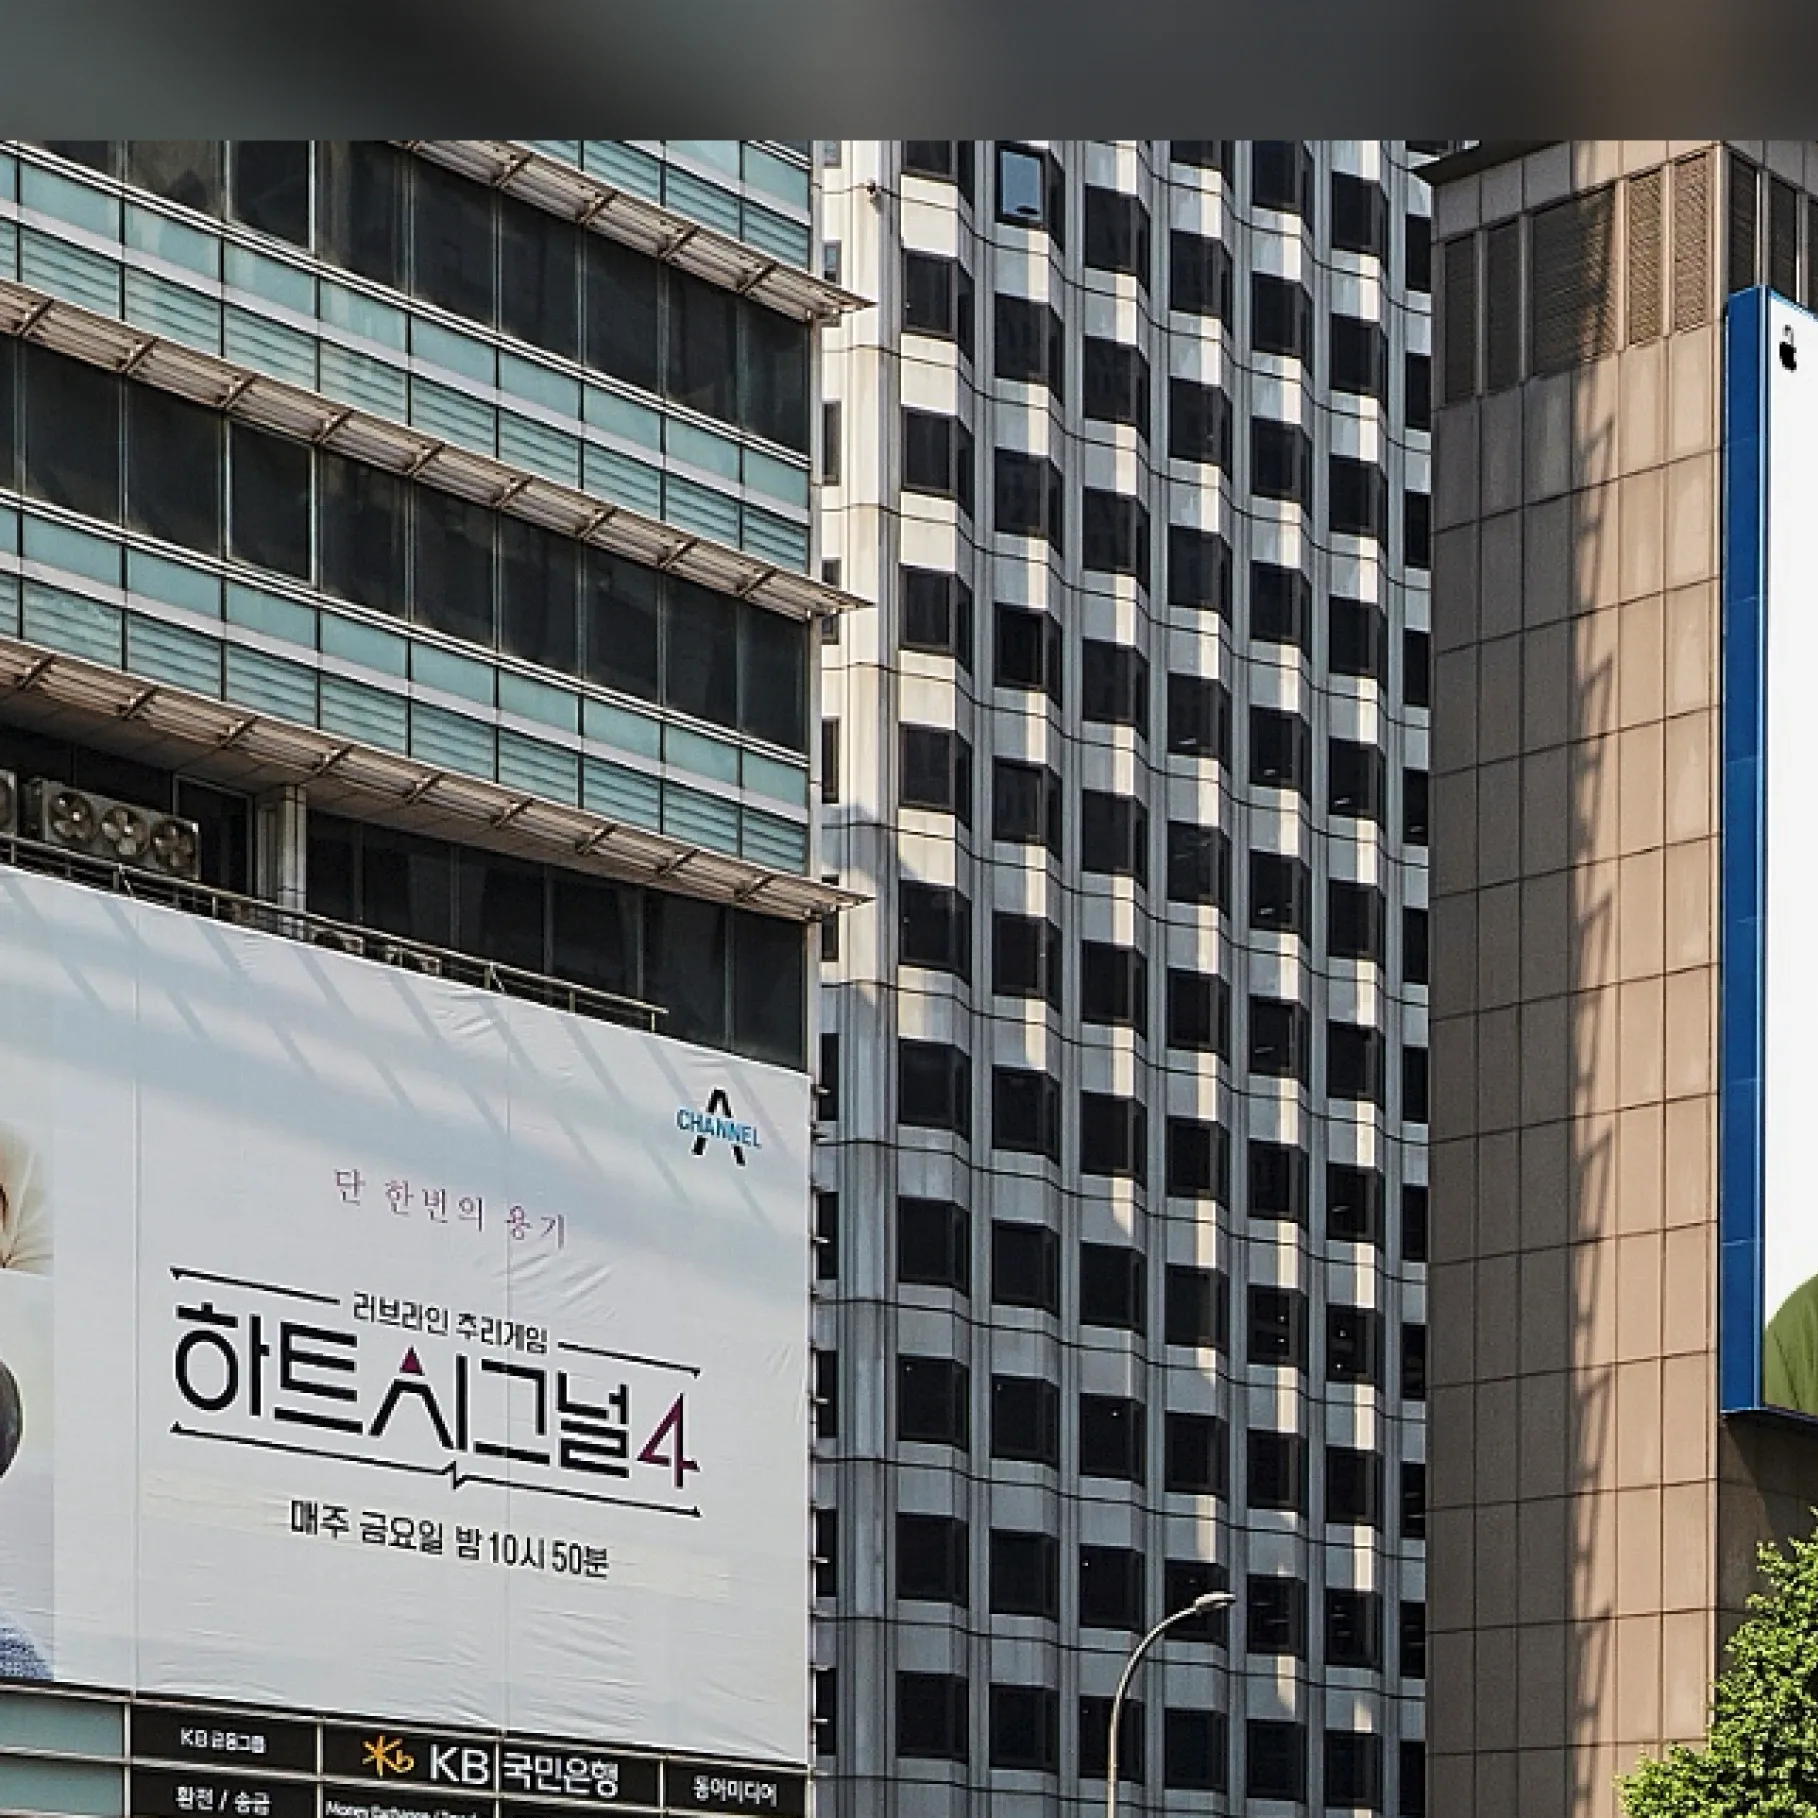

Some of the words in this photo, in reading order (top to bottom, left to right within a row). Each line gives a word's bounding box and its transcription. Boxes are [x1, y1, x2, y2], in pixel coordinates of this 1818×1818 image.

[676, 1108, 762, 1150] CHANNEL
[334, 1168, 366, 1206] 단
[504, 1204, 565, 1250] 용기
[353, 1290, 449, 1337] 러브라인
[456, 1312, 548, 1355] 추리게임
[291, 1499, 350, 1540] 매주
[359, 1509, 443, 1556] 금요일
[551, 1539, 609, 1581] 50분
